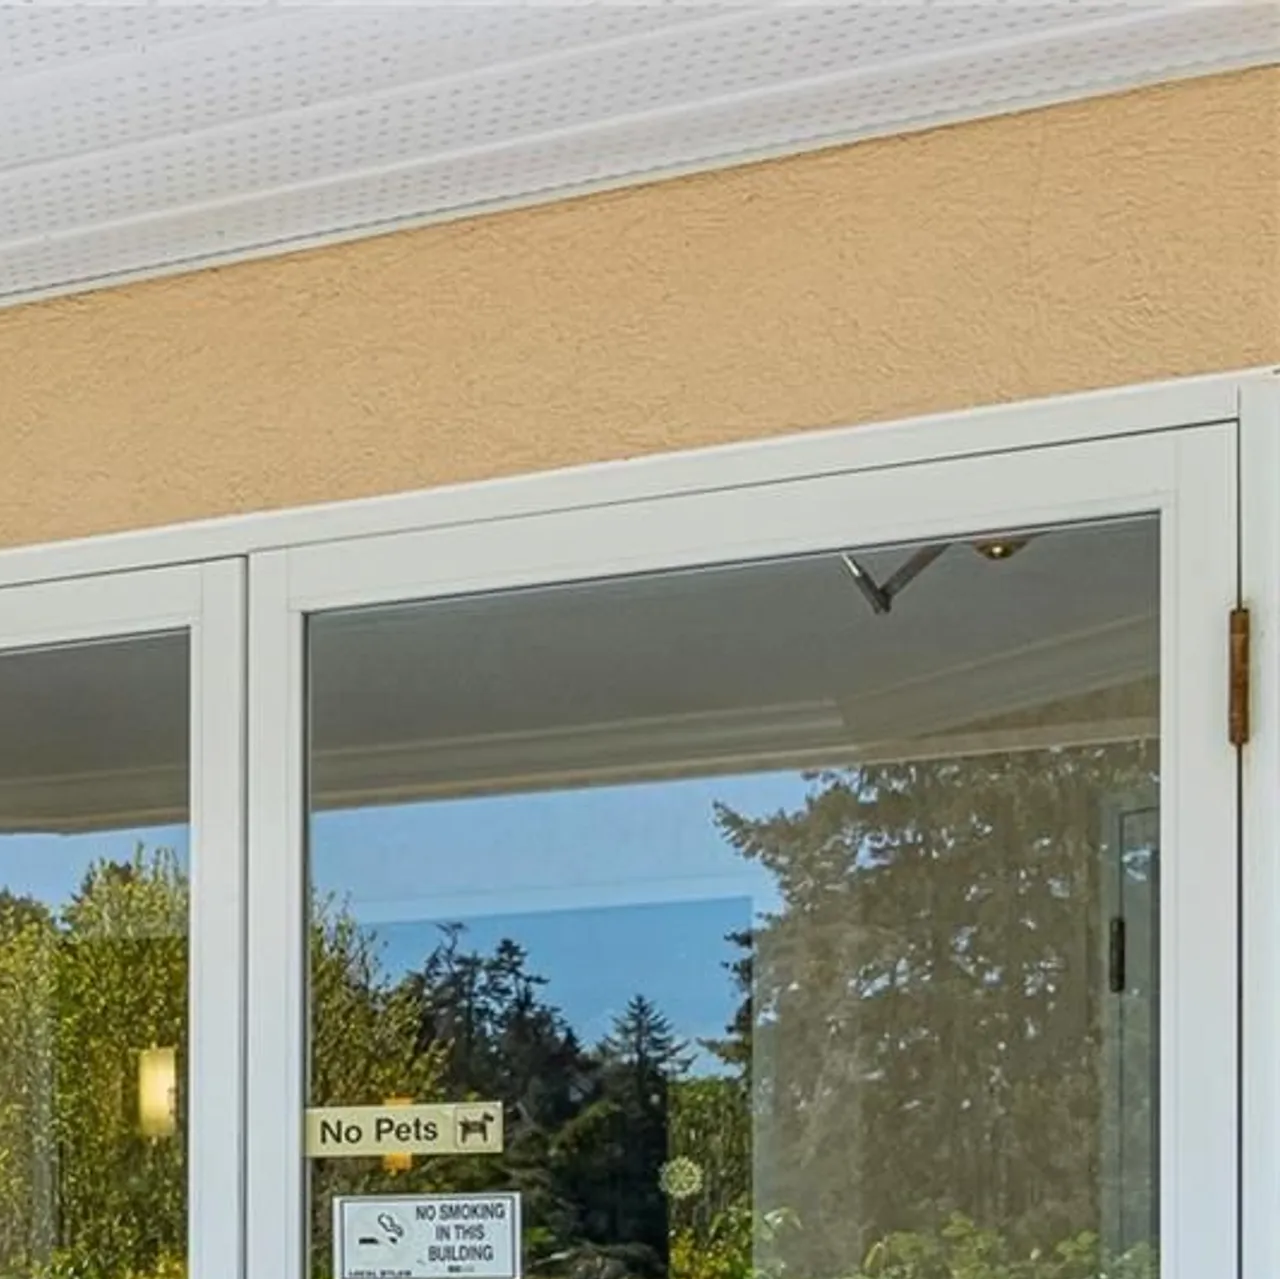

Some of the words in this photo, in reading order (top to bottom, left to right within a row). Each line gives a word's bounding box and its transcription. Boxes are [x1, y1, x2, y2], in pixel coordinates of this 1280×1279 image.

[320, 1120, 363, 1144] No
[375, 1117, 438, 1142] Pets
[415, 1206, 437, 1221] NO
[439, 1203, 506, 1221] SMOKING
[435, 1226, 451, 1241] IN
[454, 1224, 486, 1240] THIS
[427, 1245, 494, 1263] BUILDING
